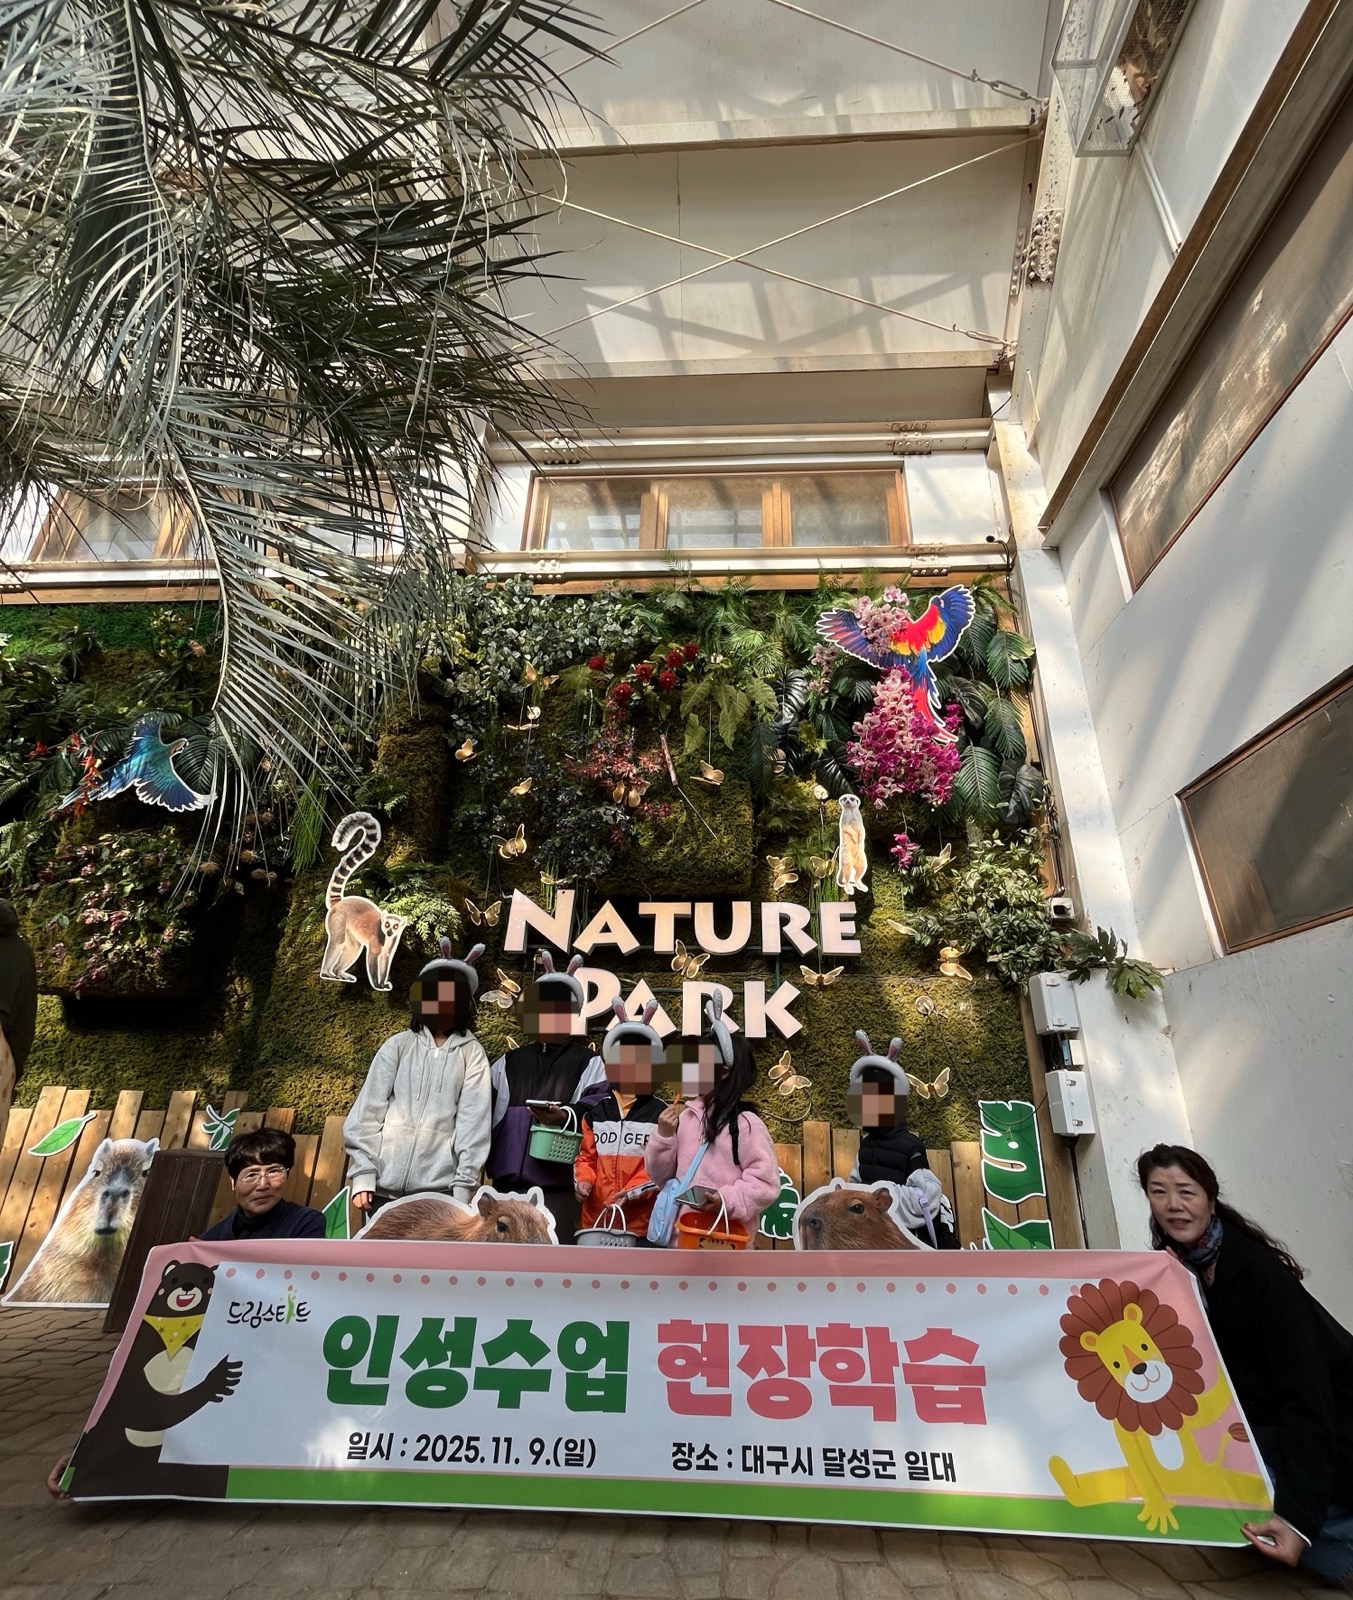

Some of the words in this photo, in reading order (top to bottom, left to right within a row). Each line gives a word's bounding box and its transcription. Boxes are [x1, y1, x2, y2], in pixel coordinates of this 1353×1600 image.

[502, 888, 862, 956] NATURE
[570, 967, 804, 1039] PARK
[322, 1314, 630, 1414] 인성수업
[657, 1318, 988, 1426] 현장학습
[347, 1431, 395, 1461] 일시
[671, 1442, 719, 1472] 장소
[741, 1444, 814, 1476] 대구시
[822, 1446, 897, 1480] 달성군
[904, 1450, 957, 1483] 일대
